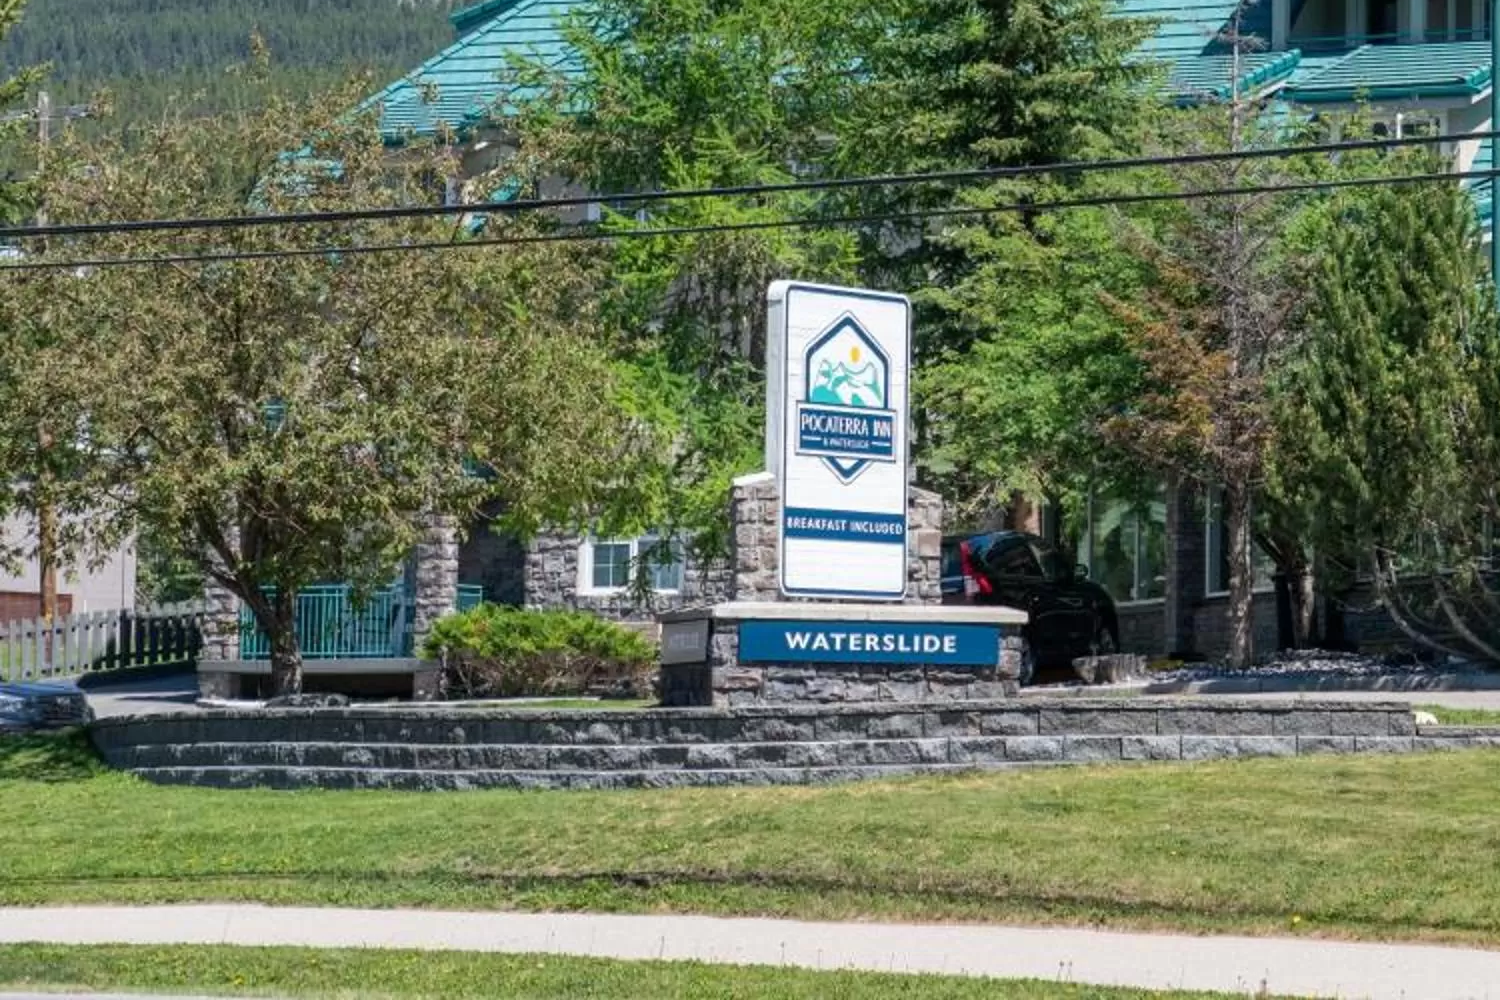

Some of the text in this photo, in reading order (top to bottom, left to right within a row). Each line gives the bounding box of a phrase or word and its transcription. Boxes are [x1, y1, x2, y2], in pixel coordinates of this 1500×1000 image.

[801, 413, 891, 438] POCATERRA INN
[787, 516, 903, 535] BREAKFAST INCLUDED
[784, 631, 957, 653] WATERSLIDE
